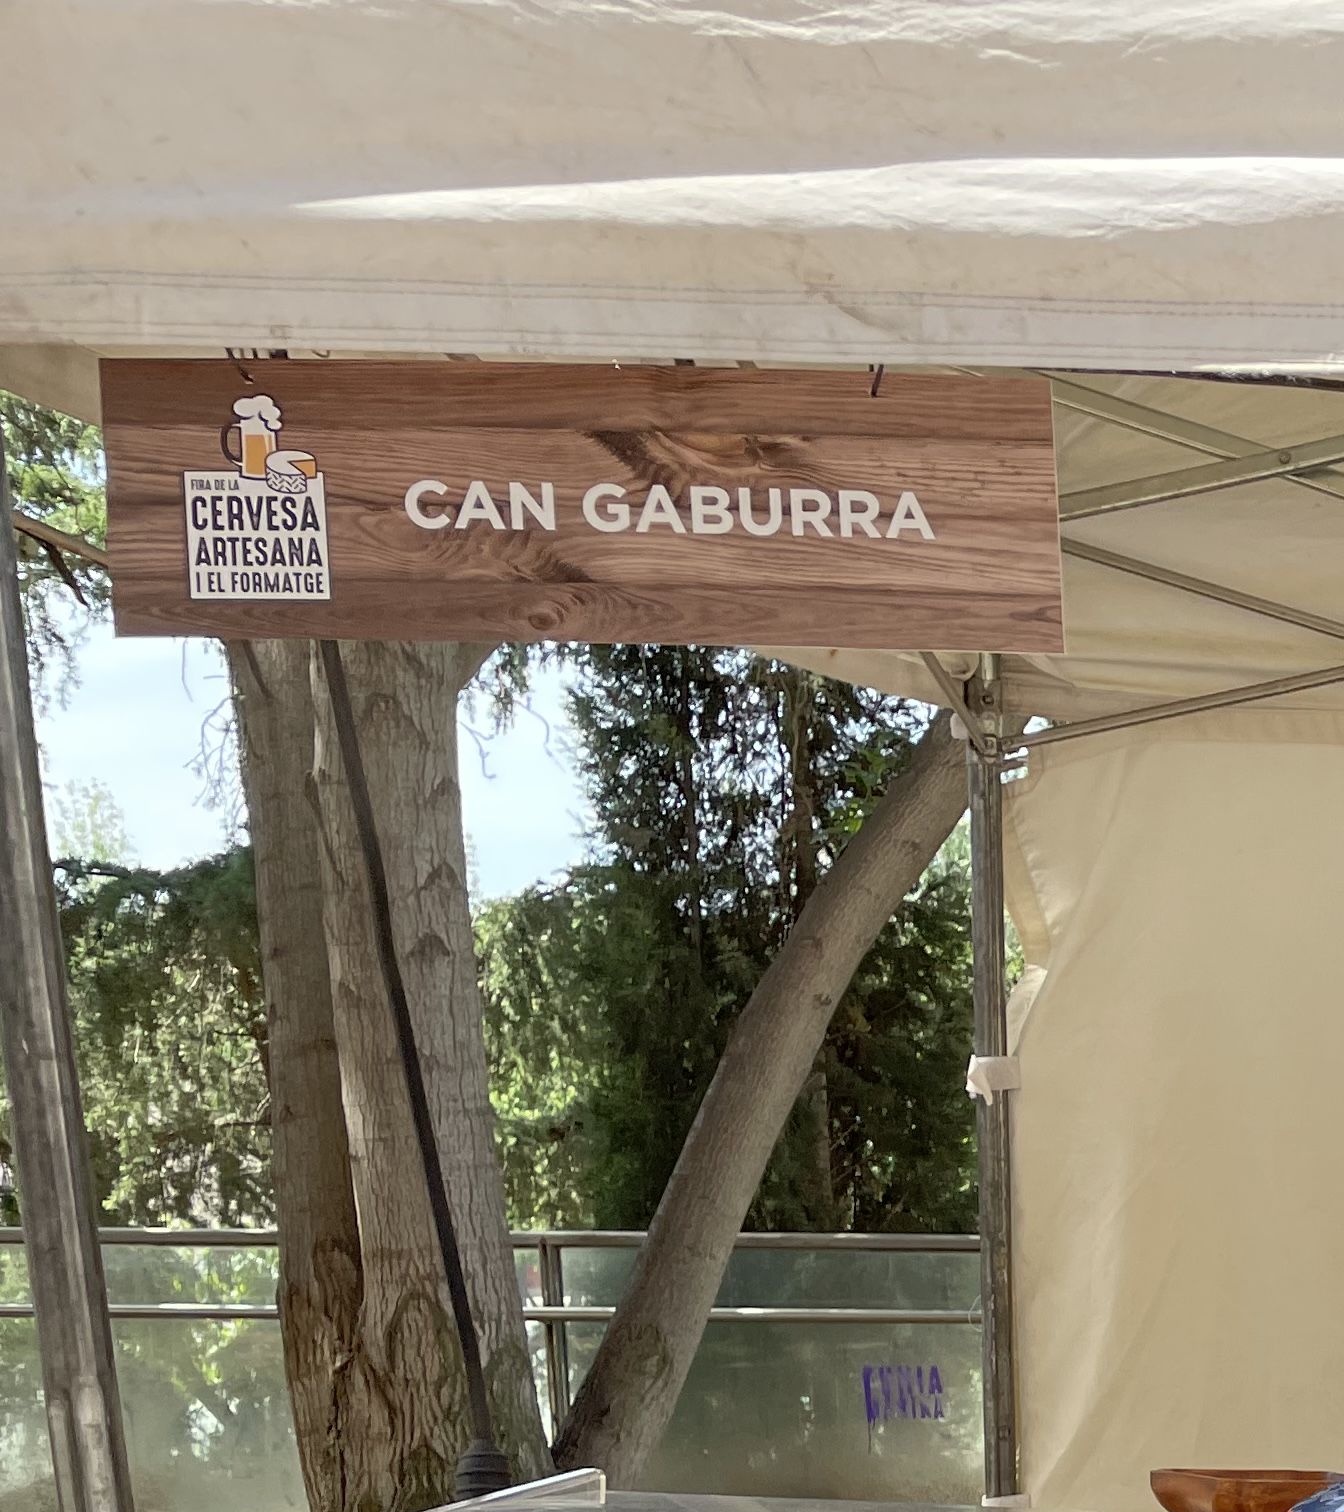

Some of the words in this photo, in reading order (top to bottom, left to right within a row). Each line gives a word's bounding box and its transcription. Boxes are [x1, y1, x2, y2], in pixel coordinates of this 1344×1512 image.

[214, 480, 226, 491] DE
[228, 480, 240, 491] LA
[191, 495, 320, 531] CERVESA
[404, 480, 556, 531] CAN
[582, 484, 936, 540] GABURRA
[195, 537, 323, 567] ARTESANA
[196, 572, 201, 593] I
[207, 572, 225, 593] EL
[231, 572, 324, 594] FORMATGE
